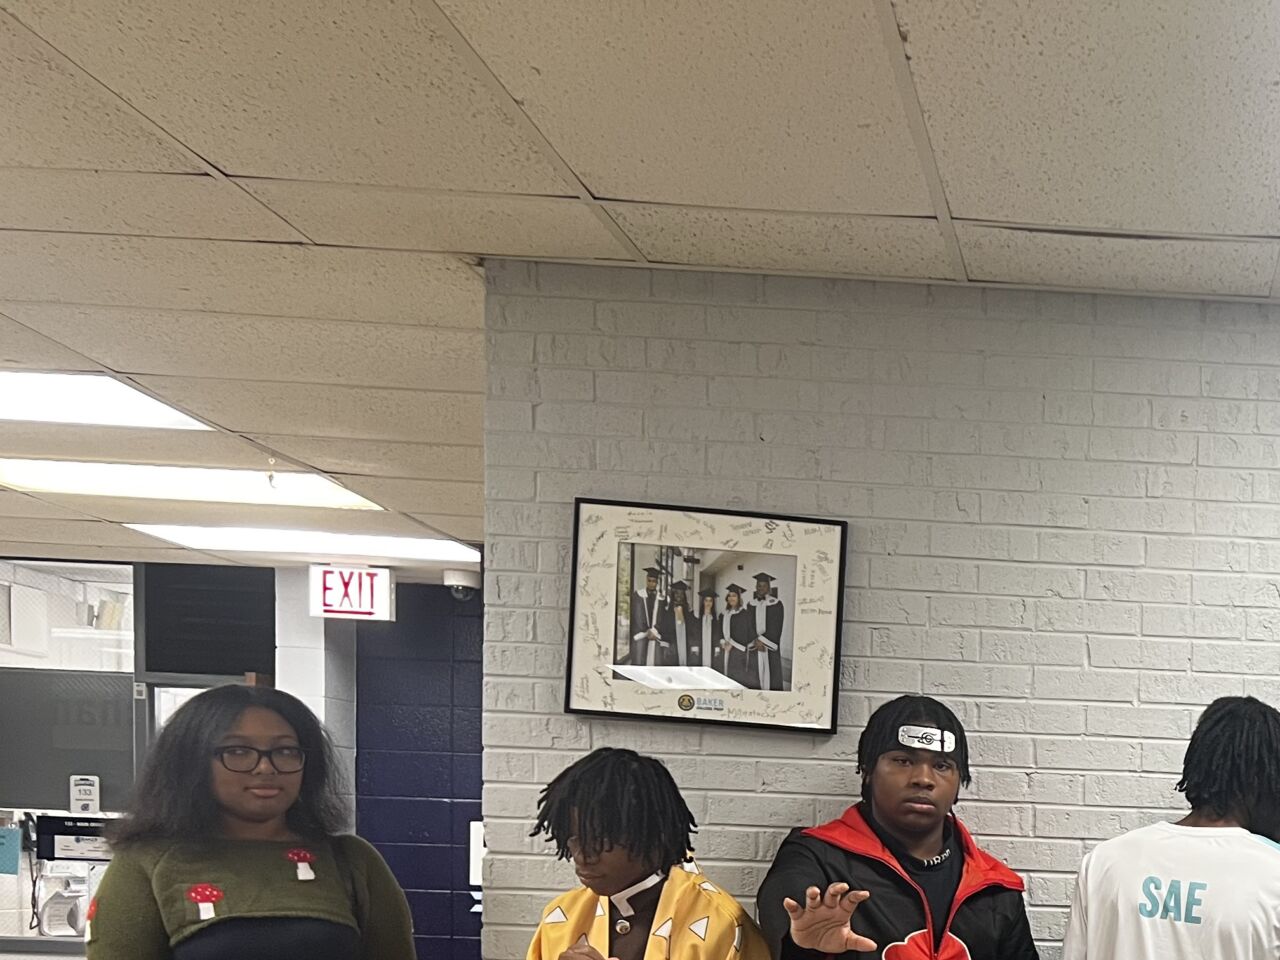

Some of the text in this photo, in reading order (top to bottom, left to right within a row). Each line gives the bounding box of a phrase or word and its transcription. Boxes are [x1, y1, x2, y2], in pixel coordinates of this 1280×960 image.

[322, 570, 378, 609] EXIT
[696, 697, 724, 707] BAKER
[78, 788, 92, 796] 133
[1138, 876, 1207, 925] SAE
